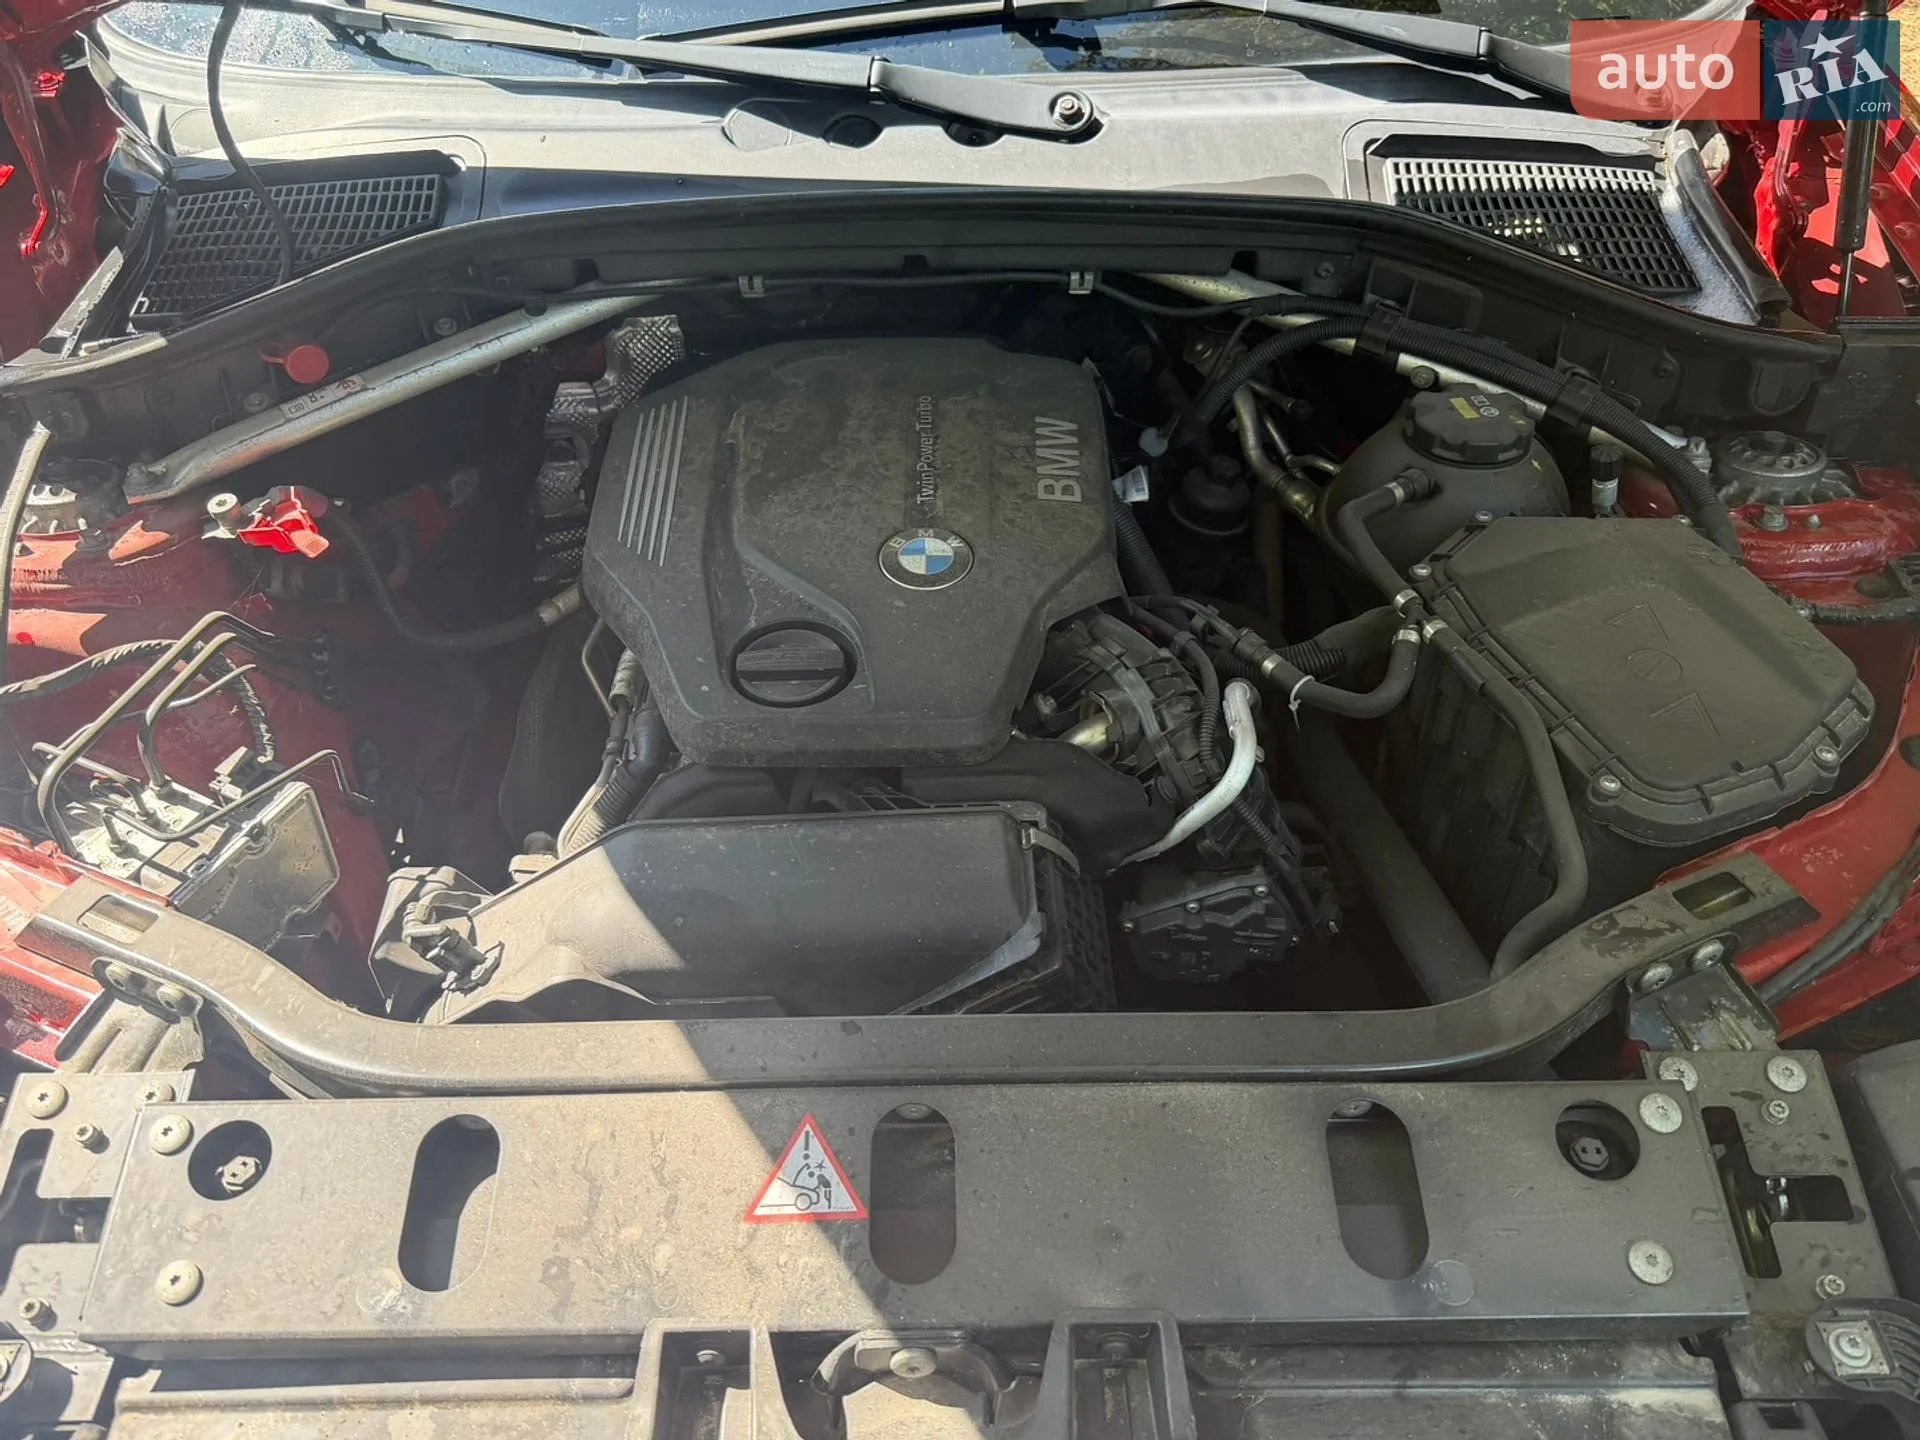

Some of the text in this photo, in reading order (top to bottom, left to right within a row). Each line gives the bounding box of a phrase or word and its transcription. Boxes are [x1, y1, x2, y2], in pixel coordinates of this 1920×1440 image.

[916, 395, 933, 431] Turbo
[1034, 416, 1082, 503] BMW
[889, 528, 964, 548] BMW
